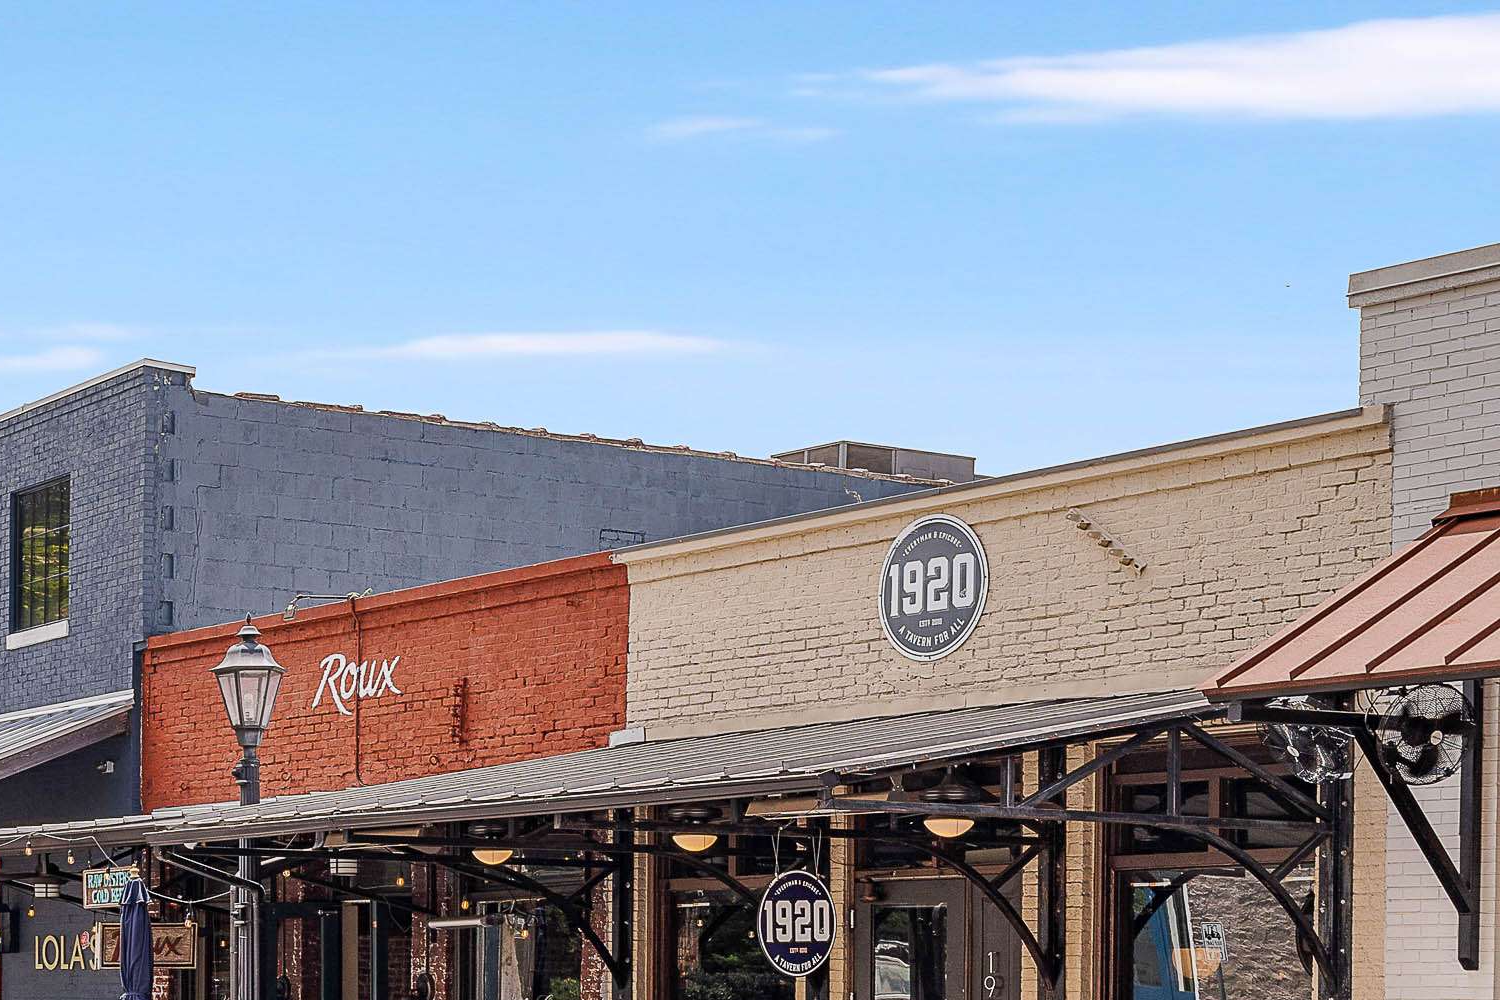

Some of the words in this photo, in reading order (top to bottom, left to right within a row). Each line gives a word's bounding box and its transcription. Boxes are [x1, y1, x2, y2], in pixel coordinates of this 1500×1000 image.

[904, 531, 933, 556] EVERYMAN
[939, 531, 960, 548] EPICURE
[889, 552, 976, 618] 1920
[898, 625, 906, 634] A
[905, 630, 932, 647] TAVERN
[934, 632, 950, 645] FOR
[951, 617, 965, 635] ALL
[311, 653, 404, 716] Roux
[87, 873, 103, 889] RAW
[91, 888, 110, 903] COLD
[764, 900, 830, 943] 1920
[774, 954, 780, 962] A
[779, 958, 801, 972] TAVERN
[801, 958, 812, 972] FOR
[812, 953, 823, 965] ALL
